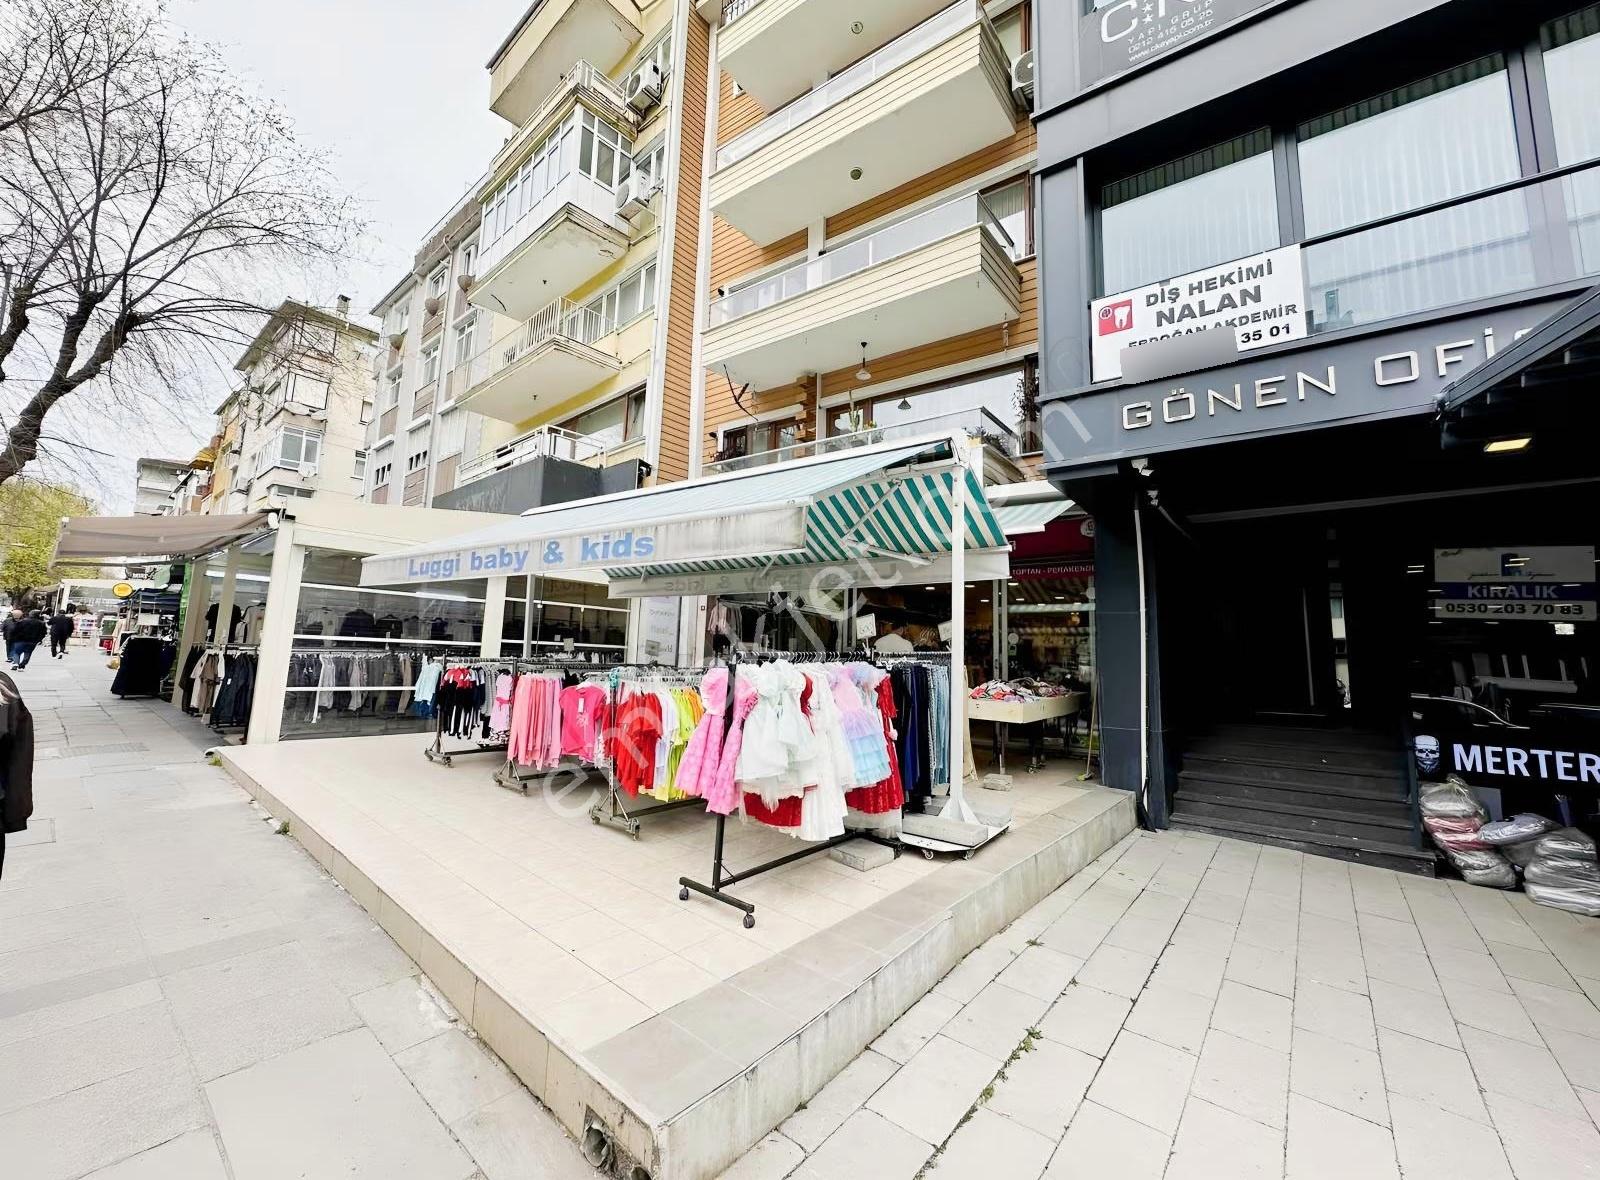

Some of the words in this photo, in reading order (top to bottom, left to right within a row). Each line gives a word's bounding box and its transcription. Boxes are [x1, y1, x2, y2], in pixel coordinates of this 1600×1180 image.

[1146, 286, 1180, 307] DİŞ
[1188, 258, 1273, 296] HEKİMİ
[1156, 284, 1262, 328] NALAN
[1240, 329, 1263, 344] 35
[1269, 322, 1292, 340] 01
[1122, 365, 1337, 431] GÖNEN
[1374, 327, 1534, 387] OFİ
[408, 552, 461, 579] Luggi
[470, 547, 529, 573] baby
[543, 539, 565, 565] &
[581, 532, 656, 562] kids
[1012, 568, 1041, 576] TOPTAN
[1445, 603, 1488, 614] 0530
[1532, 604, 1554, 615] 70
[1453, 743, 1600, 784] MERTER
